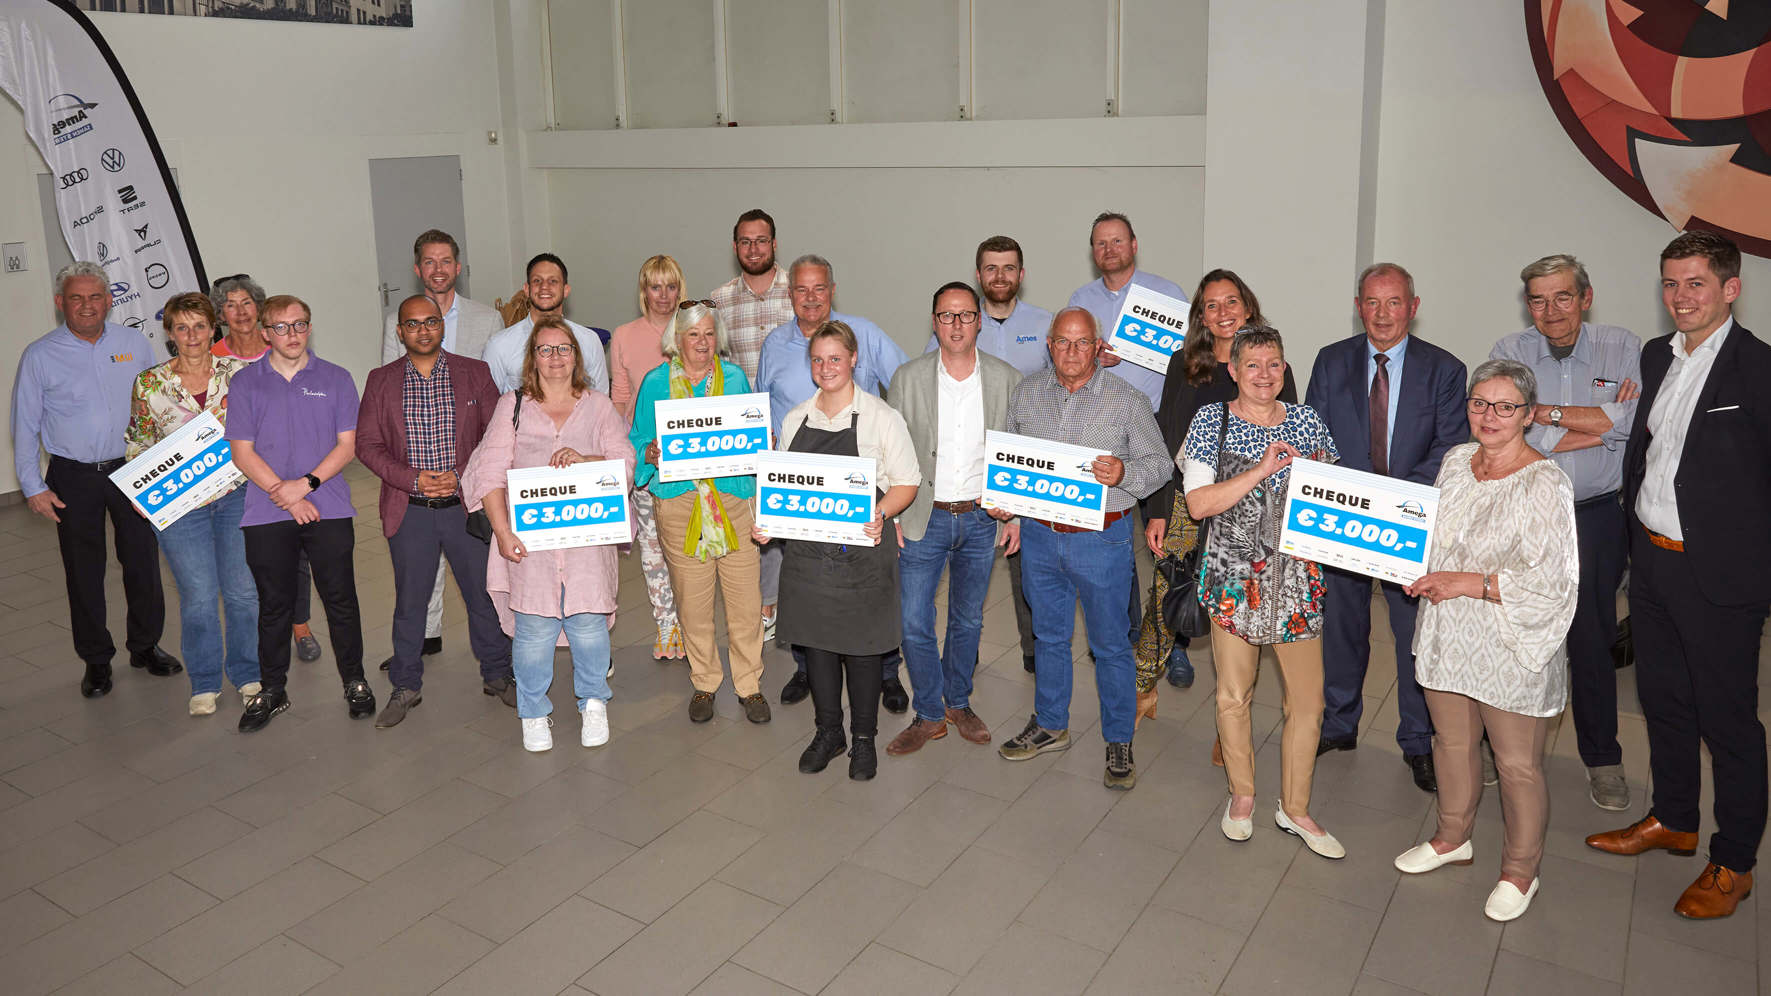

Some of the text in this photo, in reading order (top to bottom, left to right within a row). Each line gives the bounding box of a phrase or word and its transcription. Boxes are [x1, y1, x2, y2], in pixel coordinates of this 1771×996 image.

[1132, 305, 1184, 330] CHEQUE
[1124, 322, 1185, 352] € 3.00
[667, 416, 723, 429] CHEQUE
[668, 433, 762, 455] € 3.000,-
[132, 452, 184, 490] CHEQUE
[995, 452, 1055, 471] CHEQUE
[147, 489, 164, 506] €
[162, 447, 229, 496] 3.000,-
[767, 472, 825, 486] CHEQUE
[993, 471, 1096, 502] € 3.000,-
[520, 485, 577, 499] CHEQUE
[1301, 484, 1371, 510] CHEQUE
[521, 502, 619, 525] € 3.000,-
[766, 493, 865, 518] € 3.000,-
[1296, 508, 1418, 551] € 3.000,-
